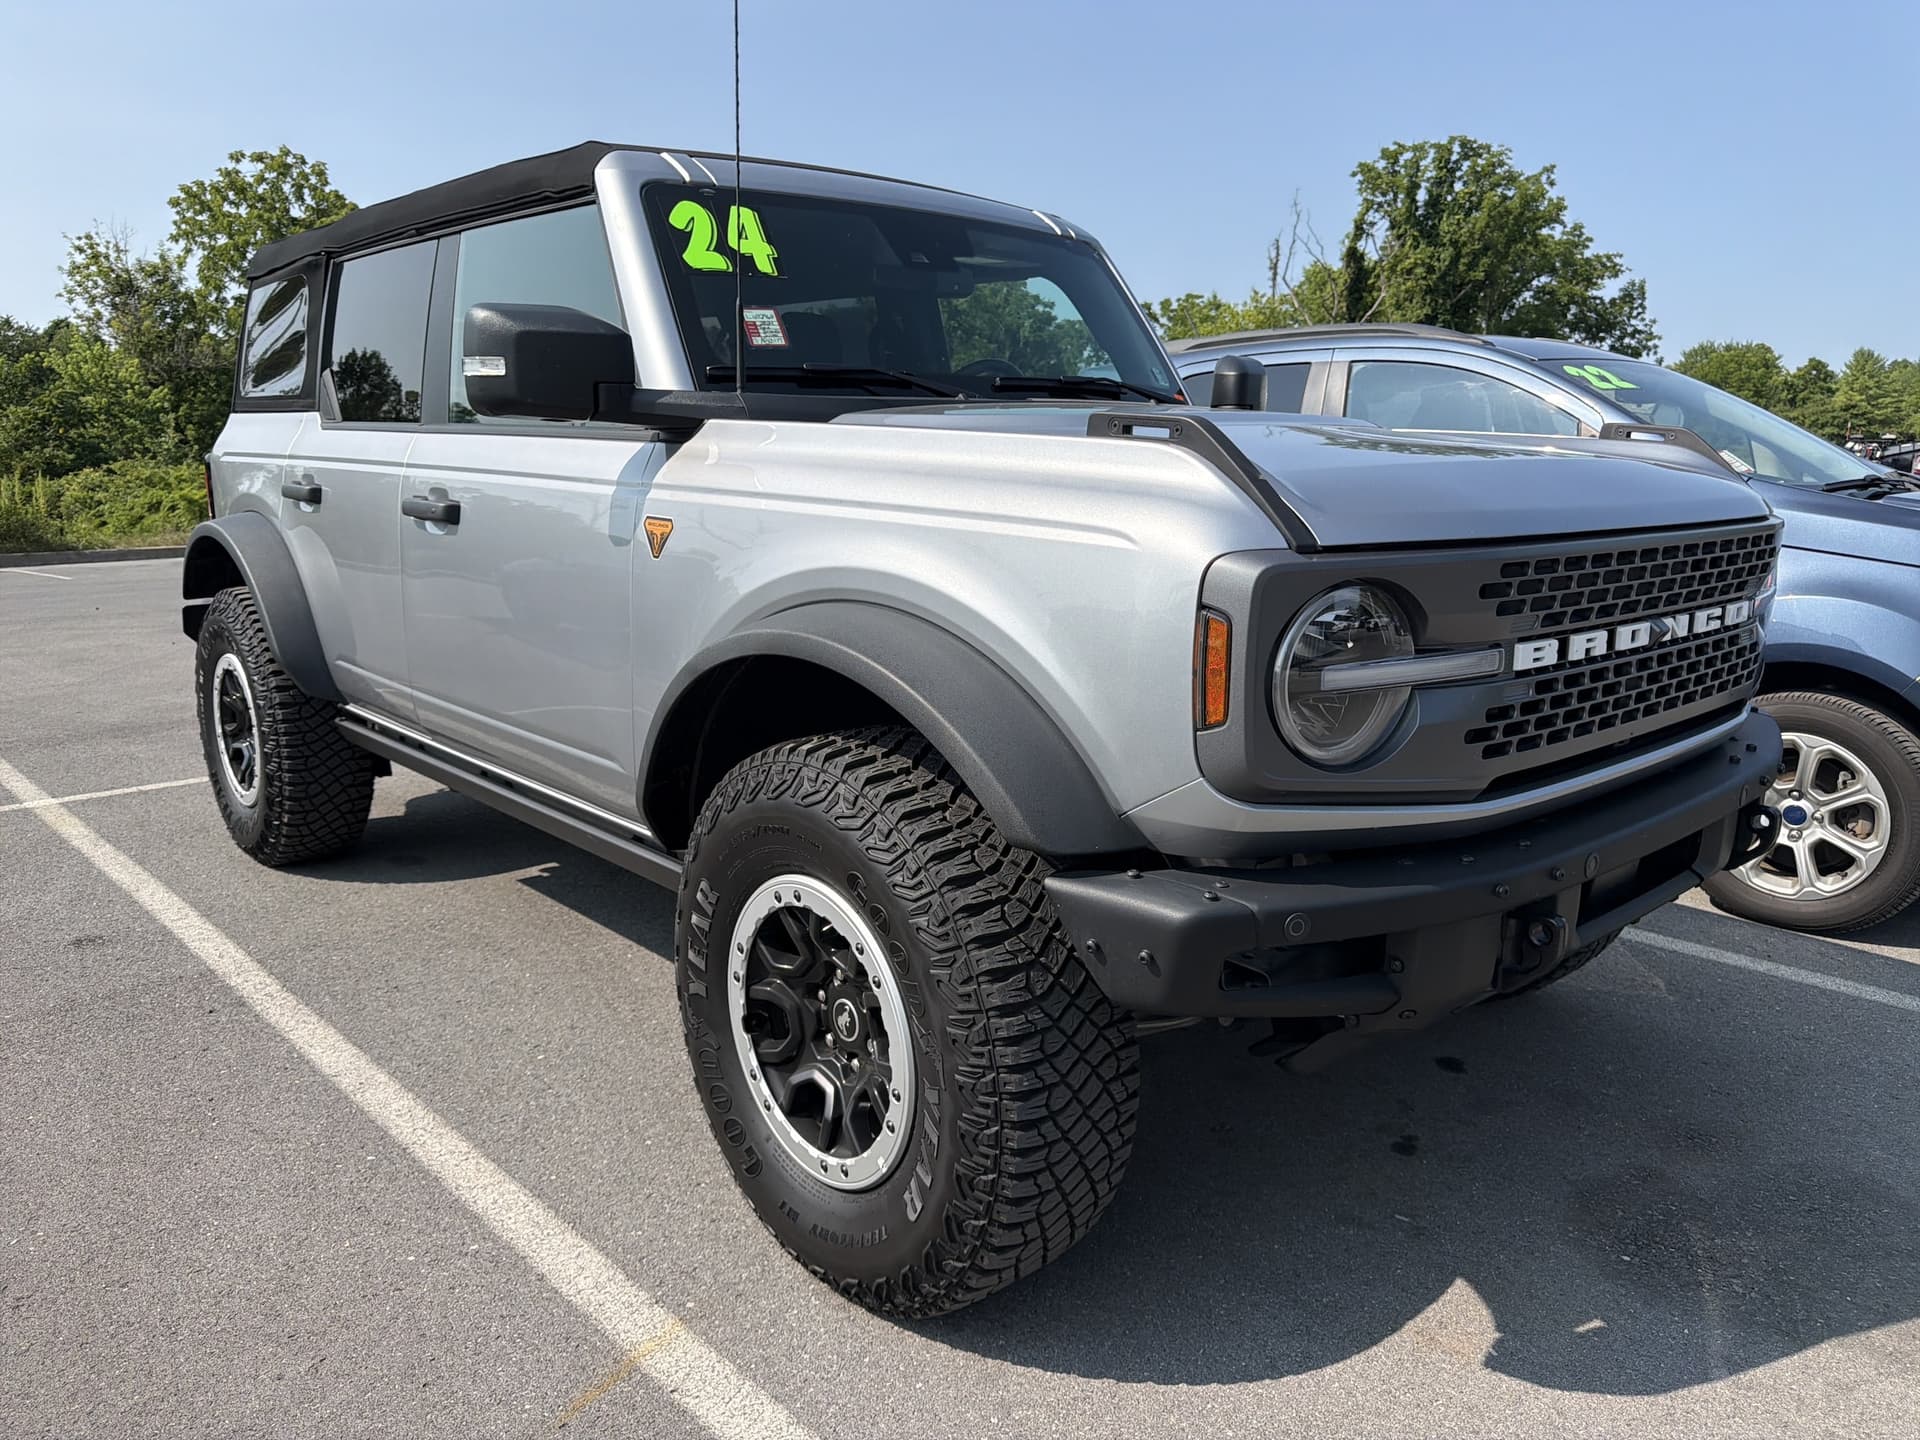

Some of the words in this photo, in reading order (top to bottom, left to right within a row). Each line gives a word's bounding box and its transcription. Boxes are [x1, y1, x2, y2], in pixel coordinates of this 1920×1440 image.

[668, 200, 778, 276] 24
[1562, 365, 1640, 390] 22
[1513, 600, 1750, 672] BRONCO
